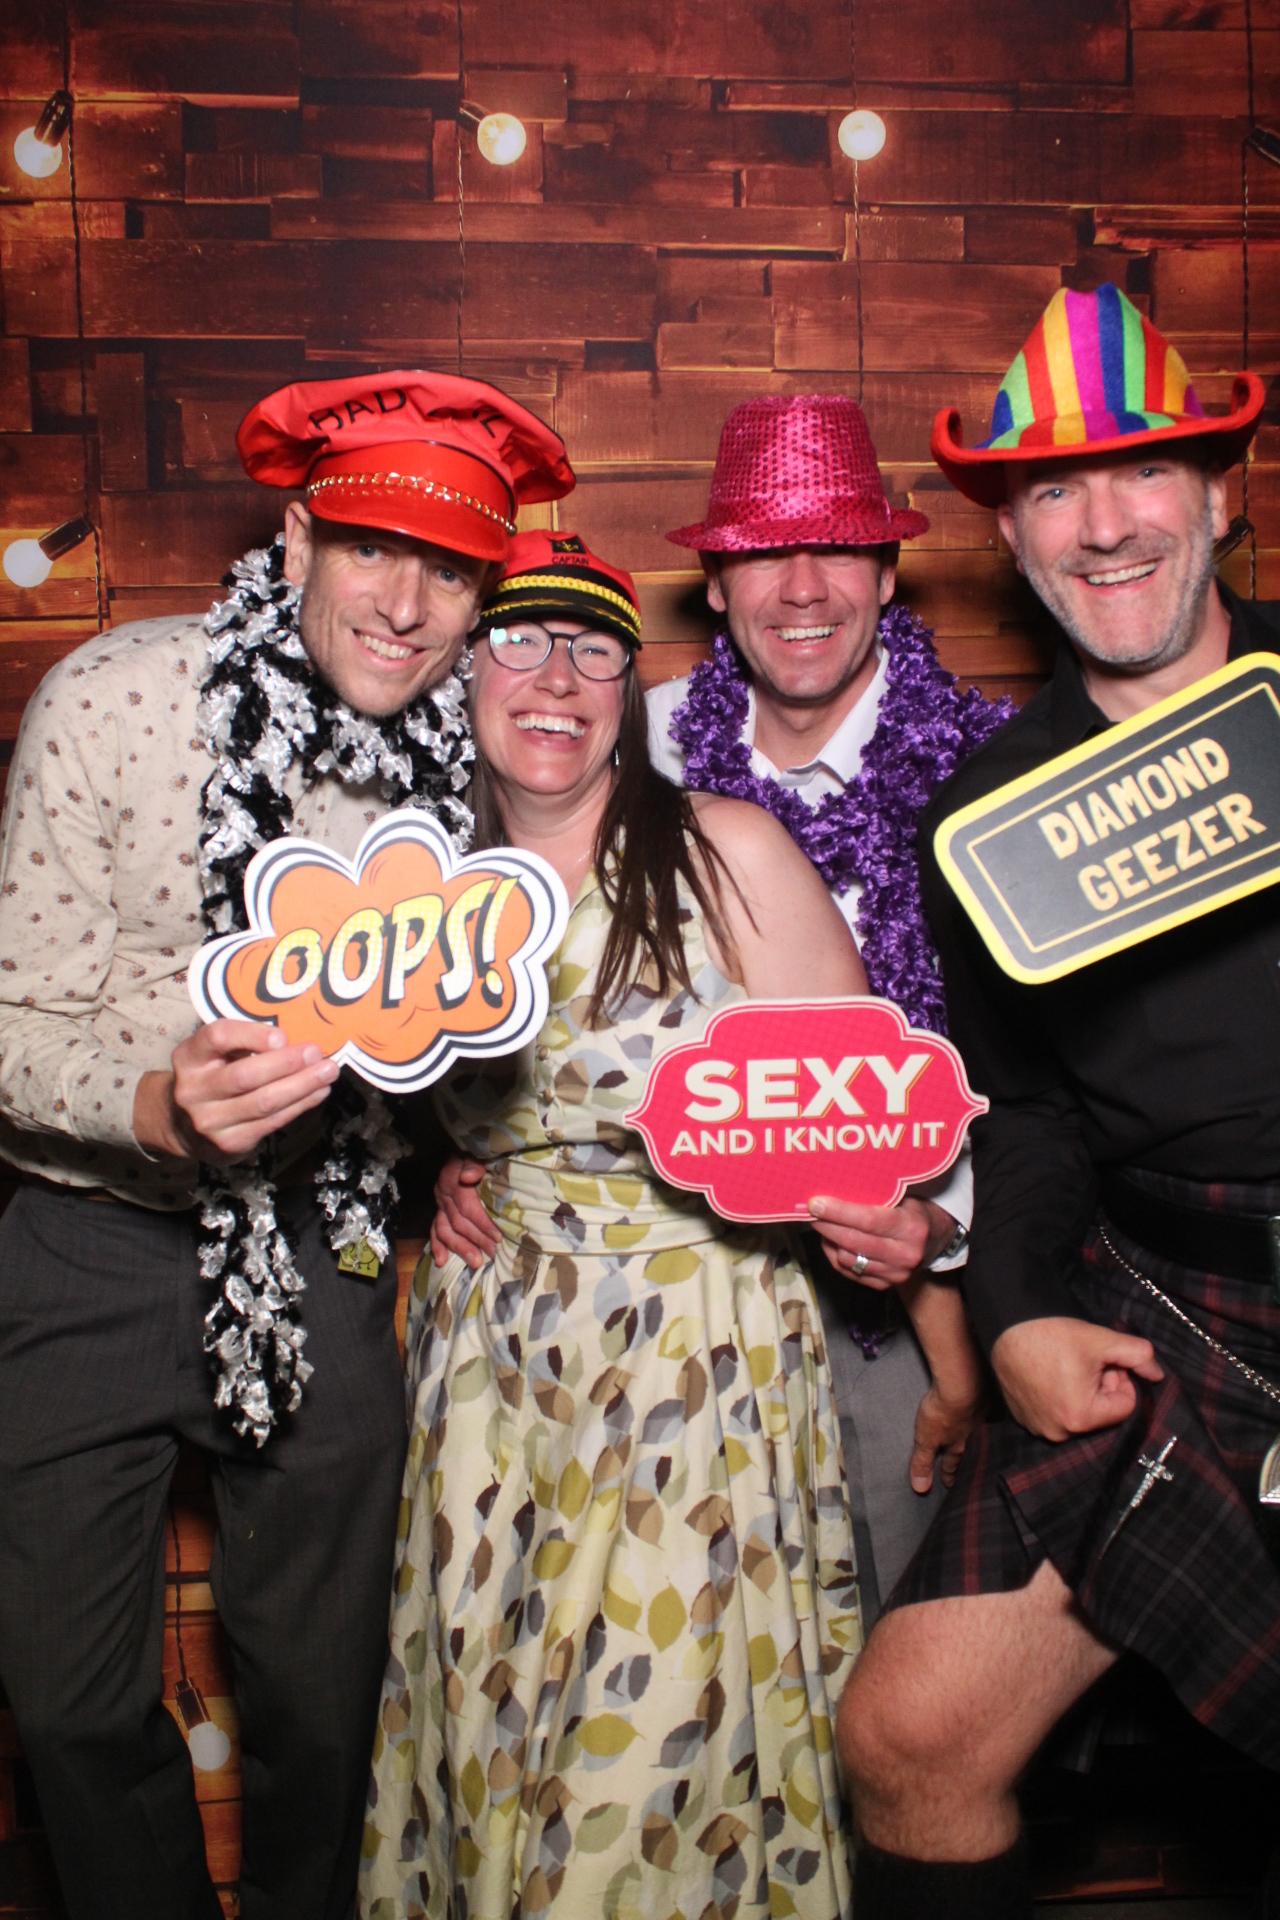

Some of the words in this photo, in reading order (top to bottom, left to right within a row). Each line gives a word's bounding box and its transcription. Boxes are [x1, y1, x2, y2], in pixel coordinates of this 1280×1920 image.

[1037, 738, 1231, 861] DIAMOND
[1077, 792, 1268, 913] GEEZER
[255, 874, 523, 1012] OOPS!
[669, 1130, 757, 1157] AND
[764, 1128, 776, 1153] I
[785, 1123, 904, 1154] KNOW
[912, 1121, 948, 1149] IT
[683, 1053, 936, 1123] SEXY
